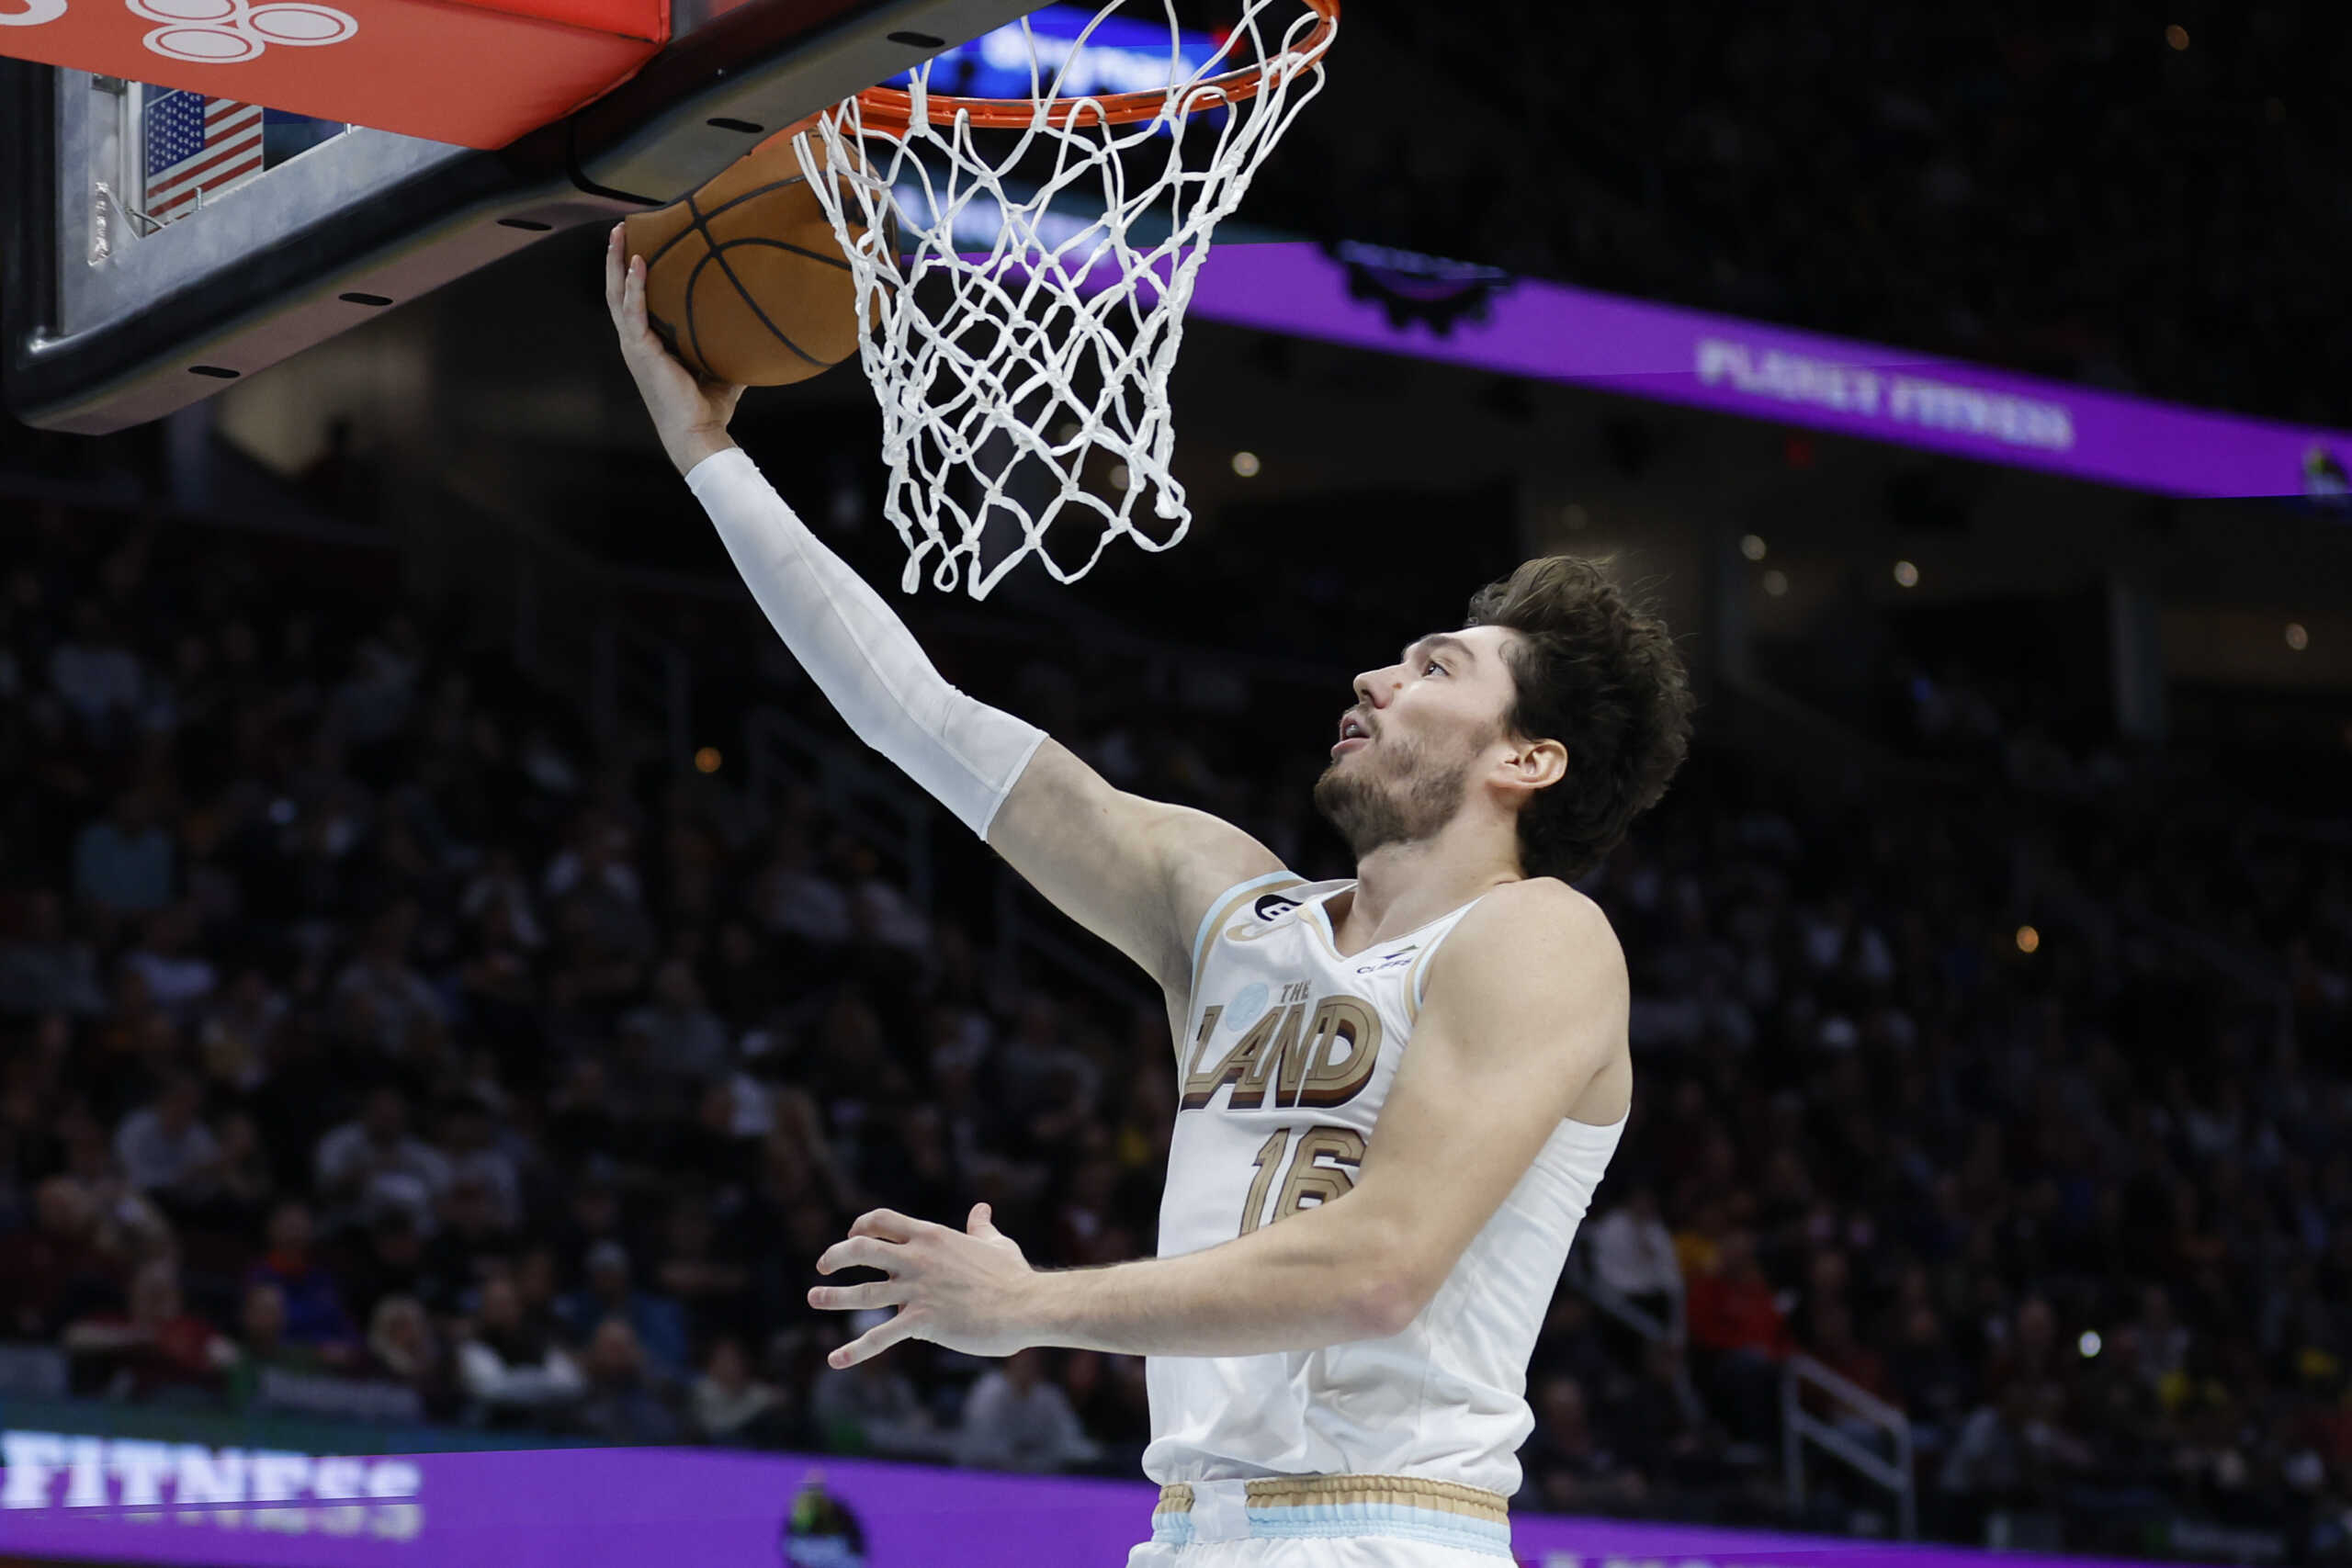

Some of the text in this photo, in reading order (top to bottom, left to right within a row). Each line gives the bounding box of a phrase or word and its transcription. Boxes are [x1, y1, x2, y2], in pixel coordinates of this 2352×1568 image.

[1280, 979, 1311, 1004] THE
[1181, 995, 1383, 1110] LAND
[1239, 1125, 1367, 1237] 16
[1, 1429, 423, 1542] FITNESS
